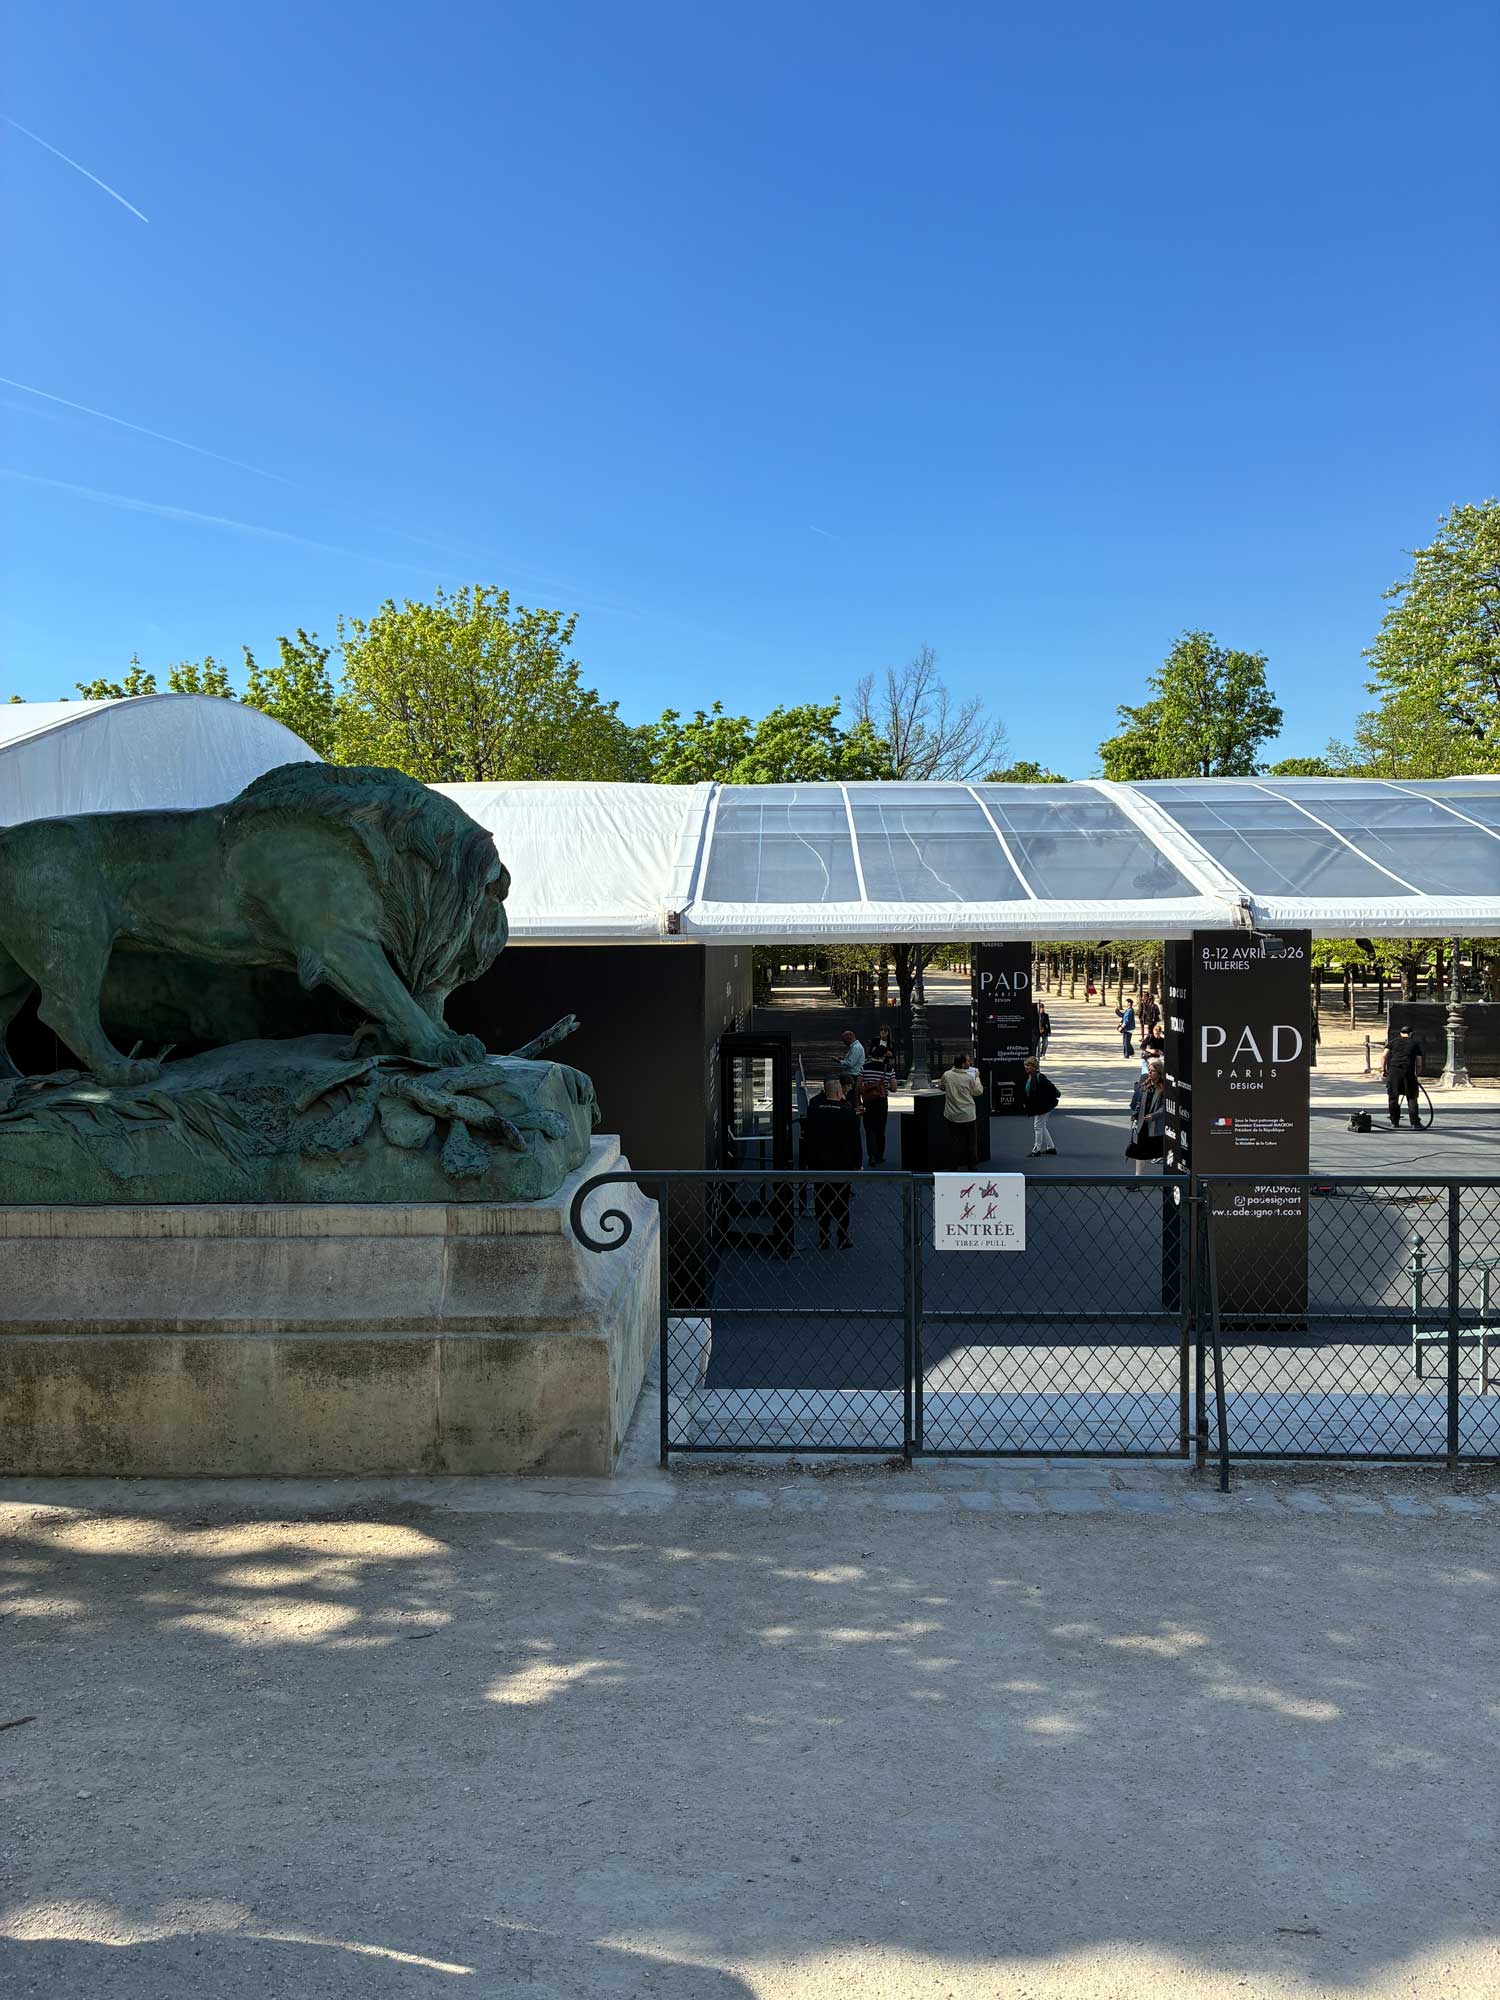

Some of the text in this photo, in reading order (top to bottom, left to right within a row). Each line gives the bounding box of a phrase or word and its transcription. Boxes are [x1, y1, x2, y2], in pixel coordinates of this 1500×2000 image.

[1202, 947, 1228, 959] 8-12
[1203, 961, 1250, 970] TUILERIES
[980, 972, 1028, 990] PAD
[1202, 1025, 1302, 1062] PAD
[1217, 1068, 1277, 1078] PARIS
[946, 1220, 1015, 1236] ENTRÉE
